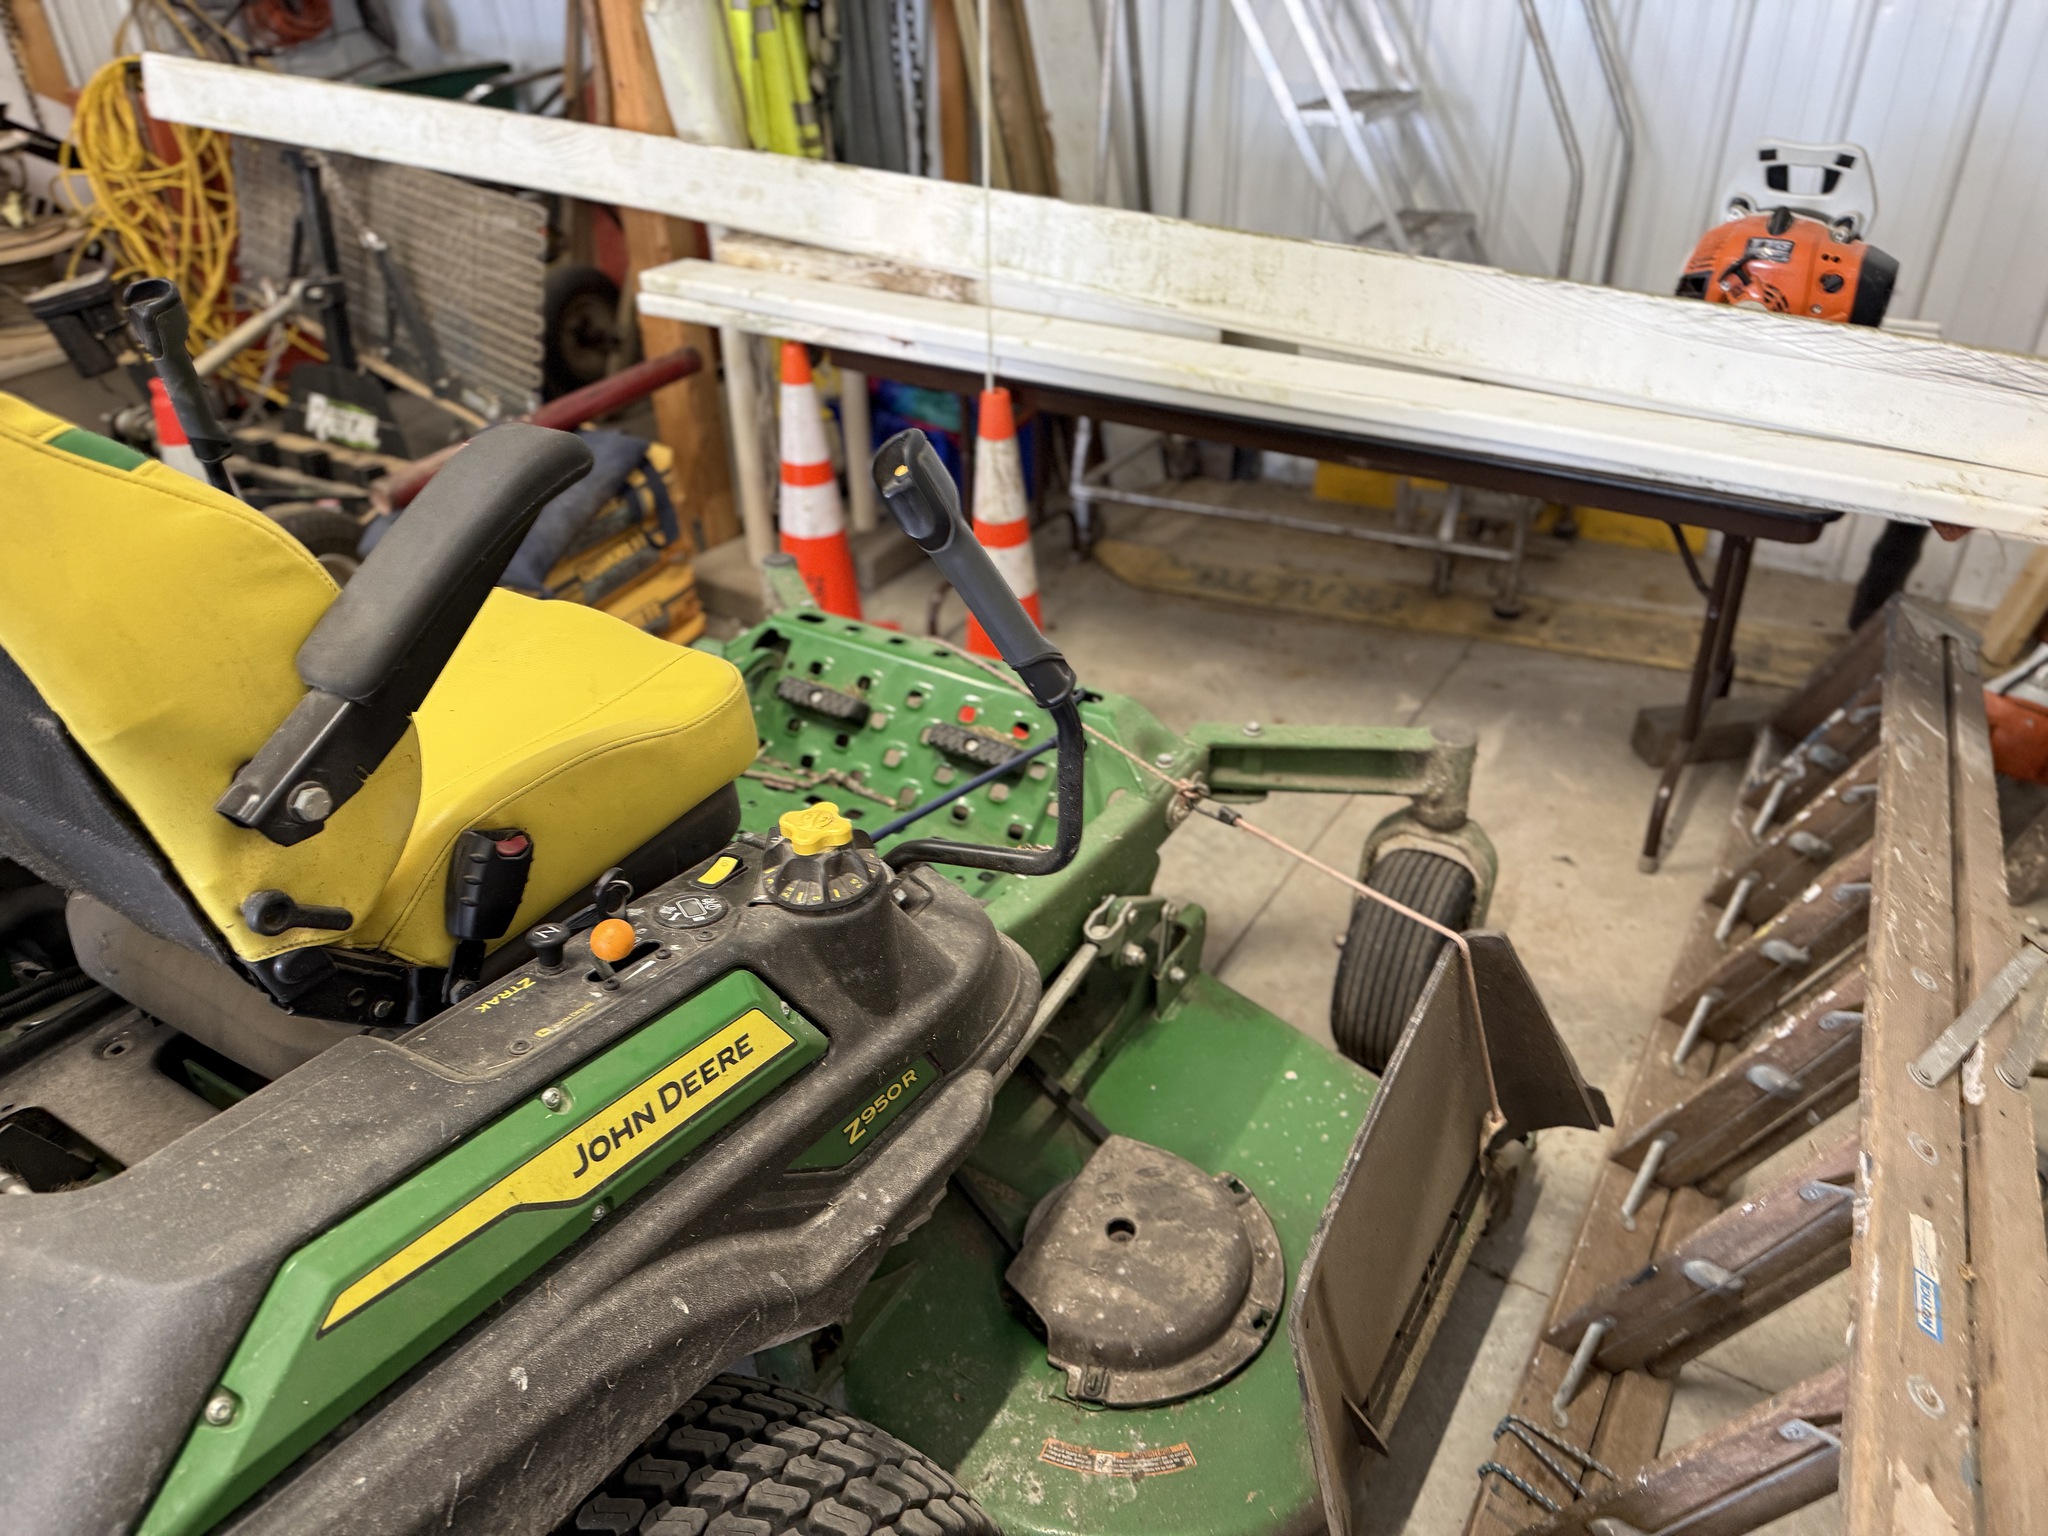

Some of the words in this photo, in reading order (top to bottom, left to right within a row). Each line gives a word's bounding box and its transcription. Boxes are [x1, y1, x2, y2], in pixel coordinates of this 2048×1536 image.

[475, 978, 536, 1013] ZTRAK
[573, 1102, 657, 1178] JOHN
[656, 1033, 755, 1114] DEERE
[842, 1067, 920, 1146] Z950R
[1919, 1277, 1936, 1331] NOTICE
